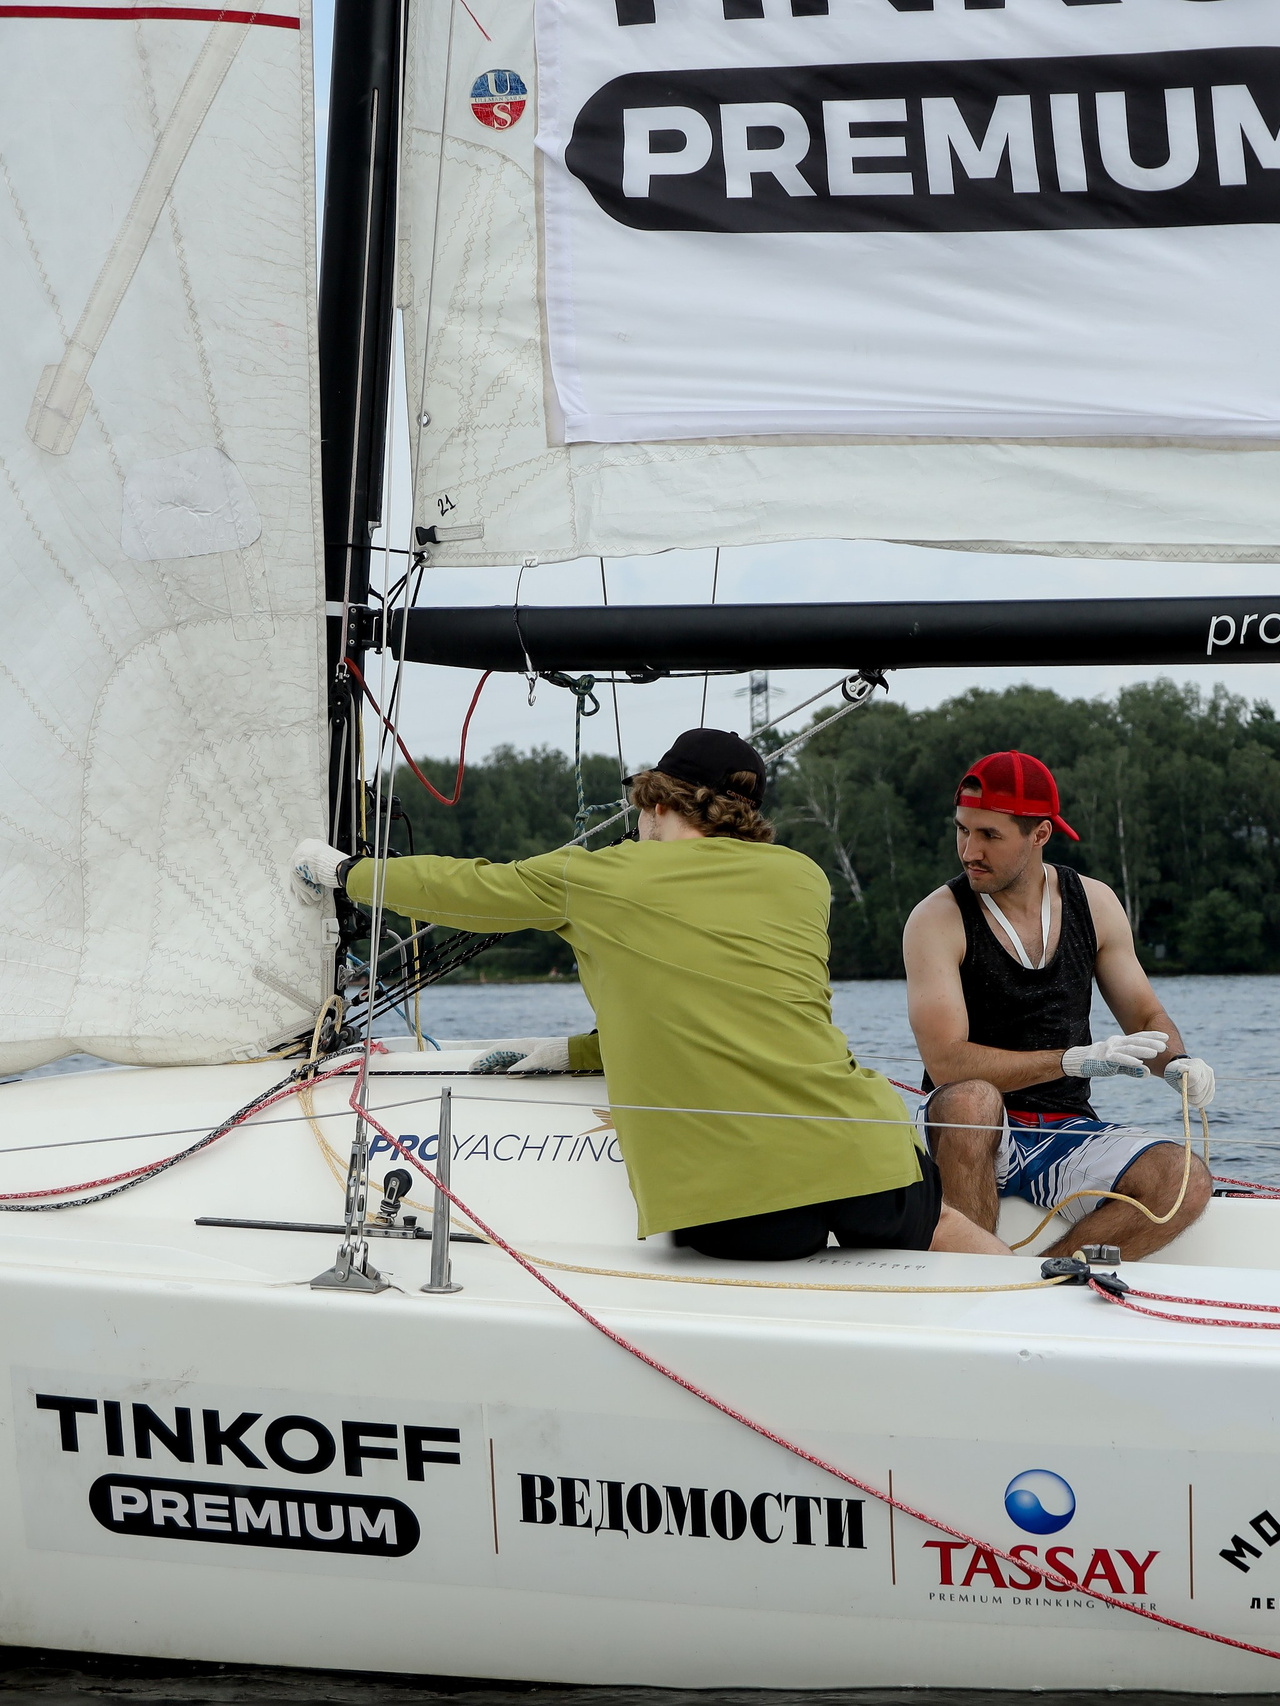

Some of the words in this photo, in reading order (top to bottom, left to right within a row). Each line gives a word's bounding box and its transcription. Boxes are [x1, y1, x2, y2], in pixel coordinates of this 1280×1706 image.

[486, 71, 511, 96] U
[492, 103, 512, 129] S
[437, 494, 457, 517] 21
[35, 1393, 461, 1482] TINKOFF
[109, 1485, 399, 1545] PREMIUM
[517, 1472, 867, 1549] ВЕДОМОСТИ
[922, 1540, 1161, 1595] TASSAY
[929, 1592, 1003, 1604] PREMIUM
[1013, 1596, 1095, 1609] DRINKING
